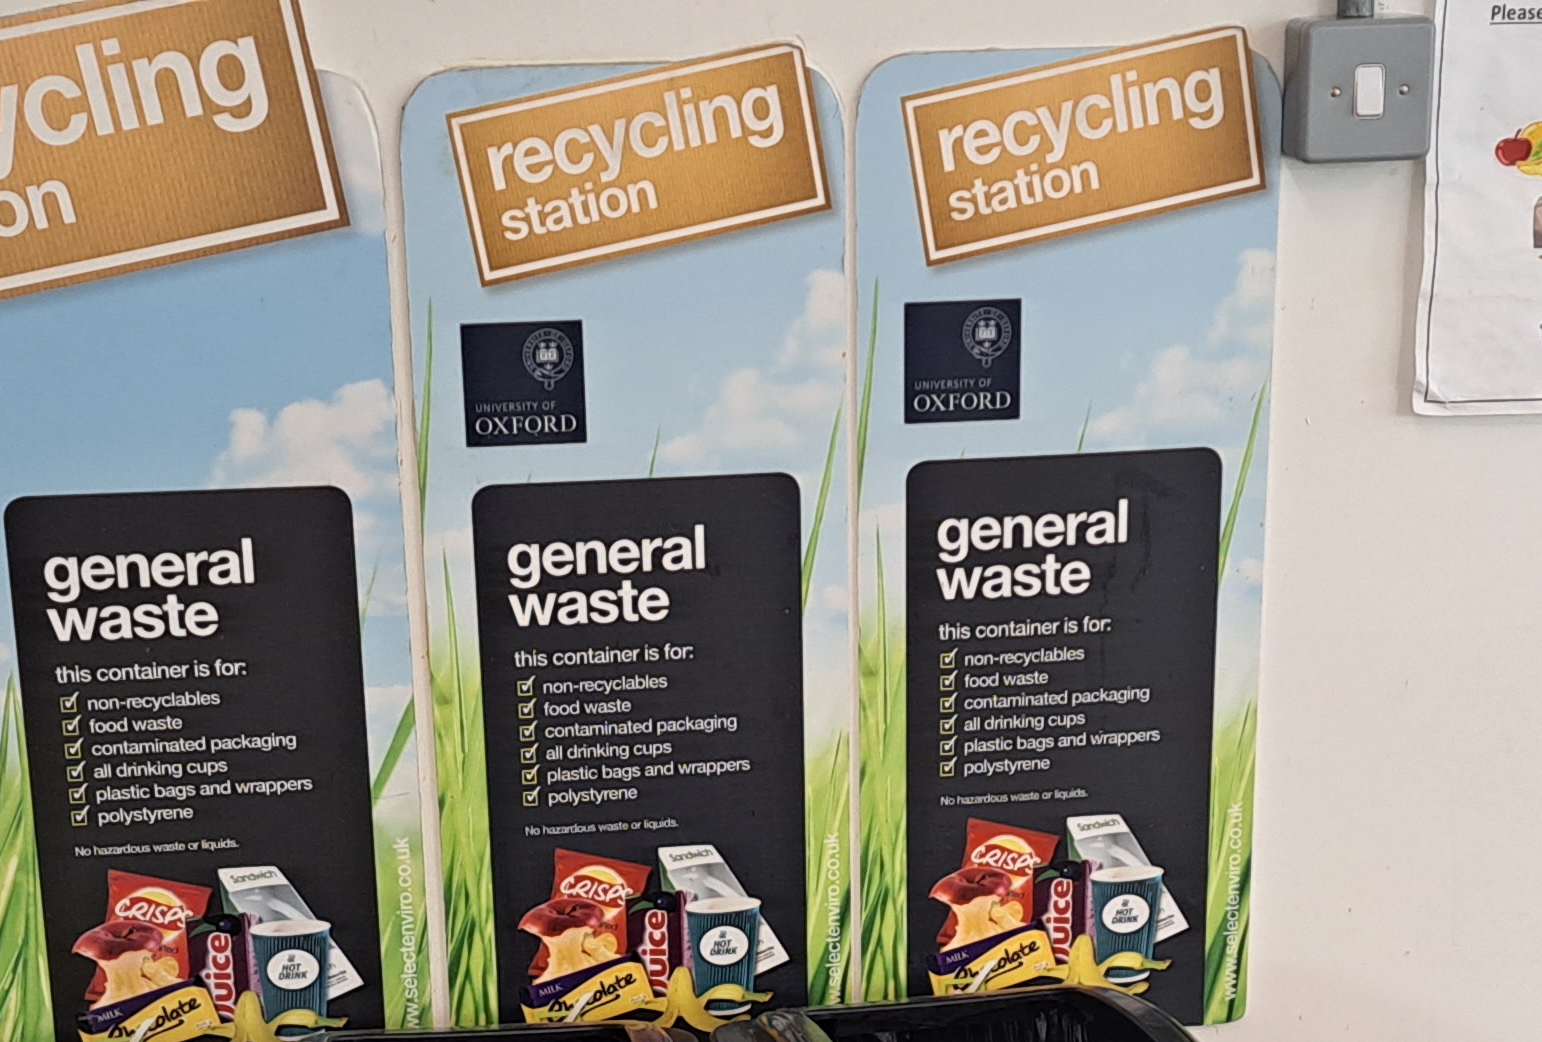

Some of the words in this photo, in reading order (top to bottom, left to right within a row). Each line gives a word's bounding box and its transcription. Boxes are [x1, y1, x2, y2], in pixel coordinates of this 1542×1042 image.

[938, 64, 1224, 173] recycling
[487, 83, 784, 191] recycling
[949, 155, 1100, 222] station
[501, 173, 657, 243] station
[915, 379, 974, 390] UNIVERSITY
[978, 377, 992, 387] OF
[475, 402, 537, 414] UNIVERSITY
[541, 400, 556, 411] OF
[913, 390, 1011, 413] OXFORD
[475, 411, 577, 436] OXFORD
[937, 498, 1128, 563] general
[508, 524, 706, 589] general
[44, 537, 255, 603] general
[936, 554, 1091, 600] waste
[509, 580, 670, 627] waste
[46, 595, 219, 642] waste
[939, 623, 971, 641] this
[975, 620, 1060, 639] container
[1063, 618, 1078, 634] is
[1083, 616, 1111, 632] for:
[515, 651, 548, 668] this
[553, 647, 640, 665] container
[645, 645, 659, 661] is
[664, 643, 694, 660] for:
[964, 648, 1085, 667] non-recyclables
[55, 665, 91, 683] this
[97, 662, 189, 682] container
[194, 661, 210, 678] is
[215, 659, 247, 677] for:
[964, 672, 999, 688] food
[1003, 672, 1049, 685] waste
[543, 674, 668, 694] non-recyclables
[87, 691, 220, 711] non-recyclables
[544, 701, 580, 716] food
[584, 700, 631, 713] waste
[964, 692, 1068, 710] contaminated
[1071, 688, 1150, 706] packaging
[89, 718, 128, 734] food
[132, 717, 183, 731] waste
[545, 720, 652, 738] contaminated
[657, 715, 737, 735] packaging
[964, 716, 981, 731] all
[984, 715, 1044, 731] drinking
[1048, 712, 1086, 727] cups
[92, 737, 206, 756] contaminated
[211, 733, 297, 752] packaging
[546, 746, 563, 761] all
[567, 744, 629, 760] drinking
[633, 741, 672, 757] cups
[964, 738, 1013, 755] plastic
[1017, 735, 1054, 752] bags
[1058, 733, 1087, 747] and
[1090, 729, 1160, 747] wrappers
[93, 763, 112, 779] all
[116, 761, 183, 778] drinking
[187, 759, 228, 775] cups
[547, 767, 598, 784] plastic
[602, 764, 640, 780] bags
[644, 761, 674, 775] and
[678, 758, 750, 775] wrappers
[964, 757, 1050, 777] polystyrene
[96, 786, 150, 804] plastic
[155, 784, 196, 801] bags
[200, 781, 231, 796] and
[235, 777, 313, 796] wrappers
[549, 787, 637, 807] polystyrene
[98, 805, 194, 827] polystyrene
[75, 847, 91, 857] No
[94, 844, 150, 855] hazardous
[152, 842, 185, 852] waste
[188, 842, 199, 850] or
[201, 838, 239, 851] liquids.
[971, 846, 1041, 875] CRISPS
[560, 876, 634, 905] CRISPS
[1223, 801, 1243, 1001] www.selectenviro.co.uk
[115, 898, 194, 929] CRISPS
[393, 837, 419, 1029] ww.selectenviro.co.uk
